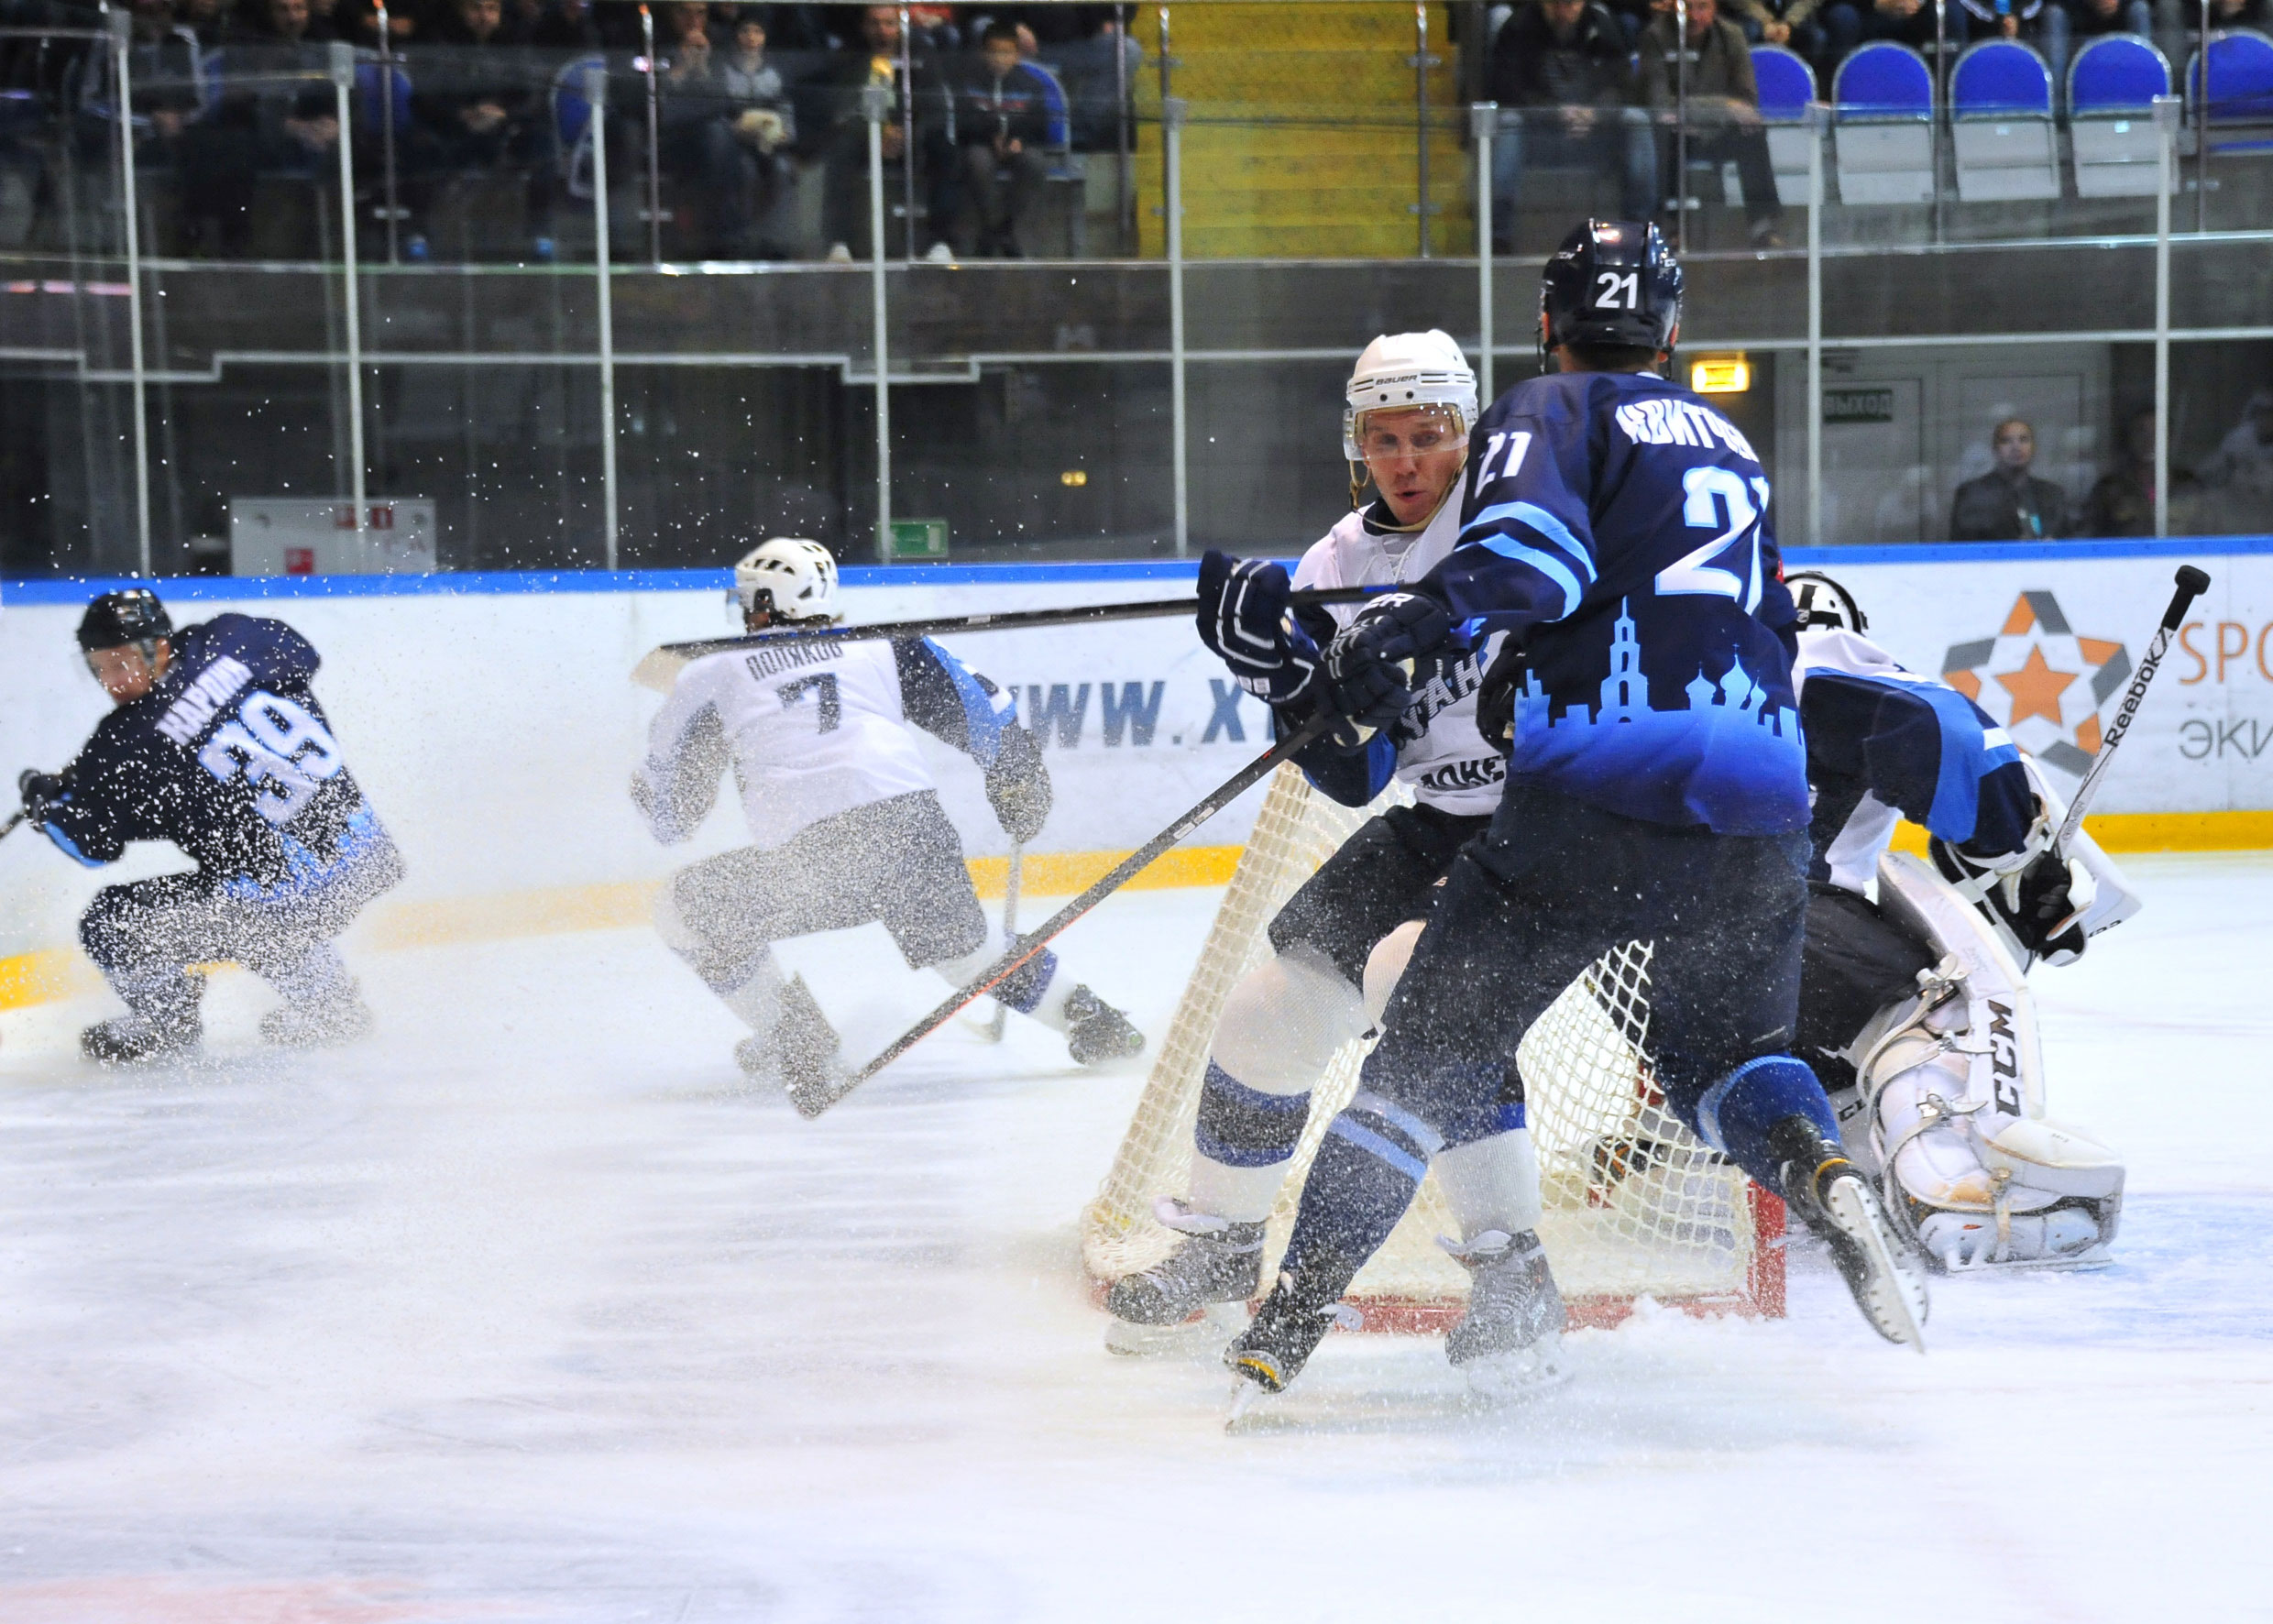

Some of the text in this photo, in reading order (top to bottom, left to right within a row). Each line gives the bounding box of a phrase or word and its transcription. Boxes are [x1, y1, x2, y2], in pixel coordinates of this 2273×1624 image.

[1595, 271, 1639, 310] 21
[1375, 375, 1418, 386] BAUER
[1473, 431, 1533, 500] 21
[1654, 466, 1770, 617] 21
[745, 642, 844, 682] ПОЛЯКОВ
[775, 671, 841, 735] 7
[2104, 648, 2166, 748] Reebok
[198, 689, 342, 827] 39
[1987, 1000, 2021, 1117] CCM
